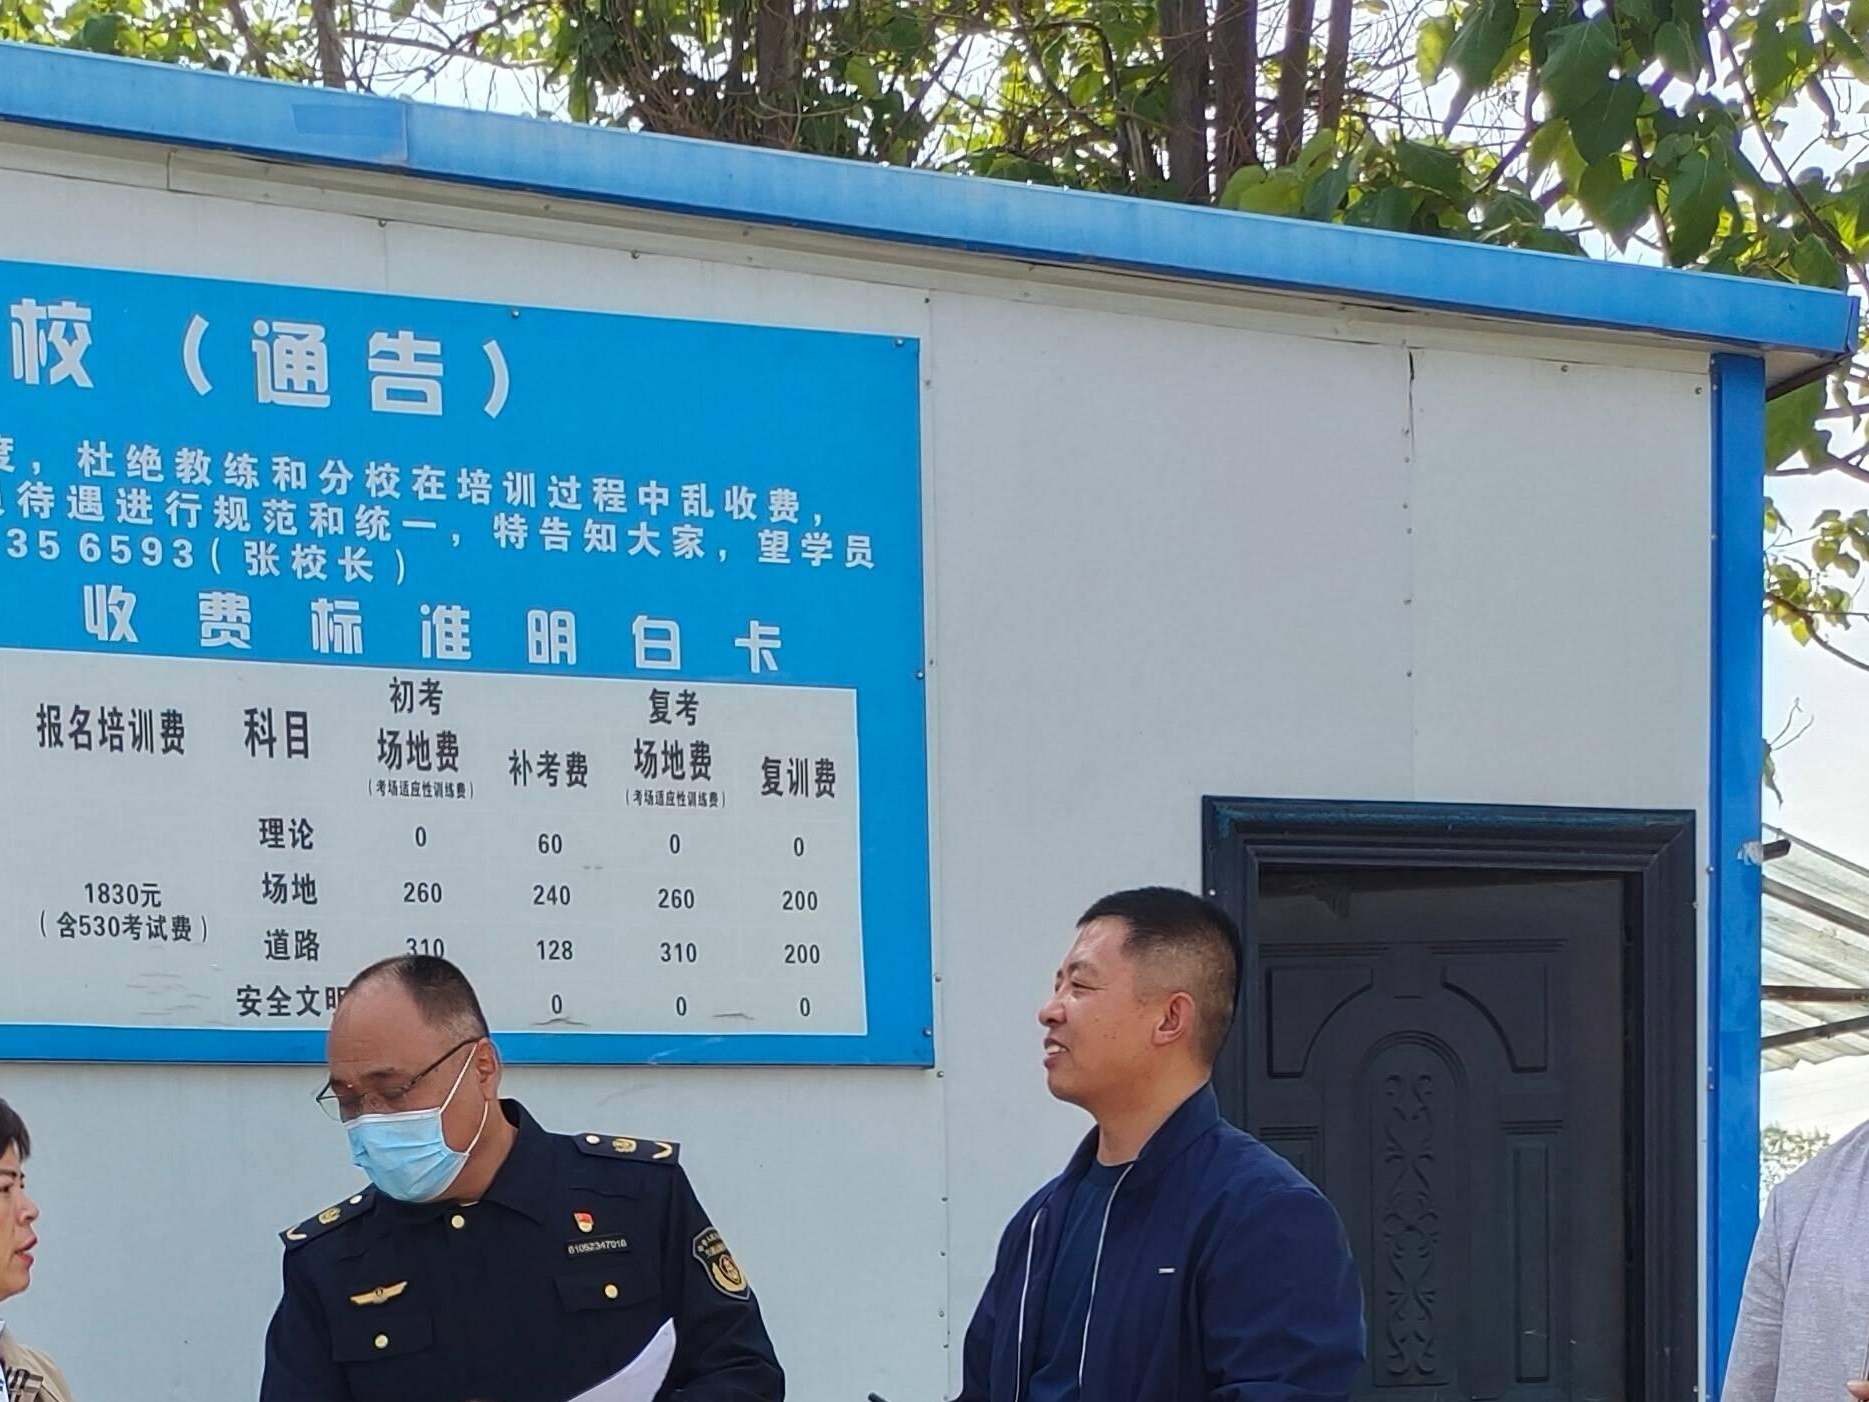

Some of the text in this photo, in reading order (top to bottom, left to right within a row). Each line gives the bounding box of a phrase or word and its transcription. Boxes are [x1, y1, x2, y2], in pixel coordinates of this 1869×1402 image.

[82, 584, 782, 675] 收费标准明白卡
[389, 676, 443, 716] 初考
[649, 687, 699, 727] 复考
[36, 703, 185, 755] 报名培训费
[243, 707, 309, 759] 科目
[377, 727, 459, 773] 场地费
[633, 737, 712, 781] 场地费
[508, 749, 588, 789] 补考费
[761, 756, 836, 799] 复训费
[258, 817, 314, 850] 理论
[415, 826, 427, 847] 0
[538, 833, 563, 854] 60
[669, 833, 681, 854] 0
[793, 836, 805, 857] 0
[84, 882, 162, 908] 1830元
[261, 871, 318, 905] 场地
[403, 881, 442, 904] 260
[533, 884, 571, 906] 240
[658, 888, 695, 909] 260
[782, 890, 818, 911] 200
[263, 928, 320, 962] 道路
[536, 939, 573, 961] 128
[660, 942, 697, 963] 310
[784, 944, 820, 964] 200
[551, 994, 563, 1015] 0
[676, 996, 687, 1017] 0
[799, 997, 811, 1017] 0
